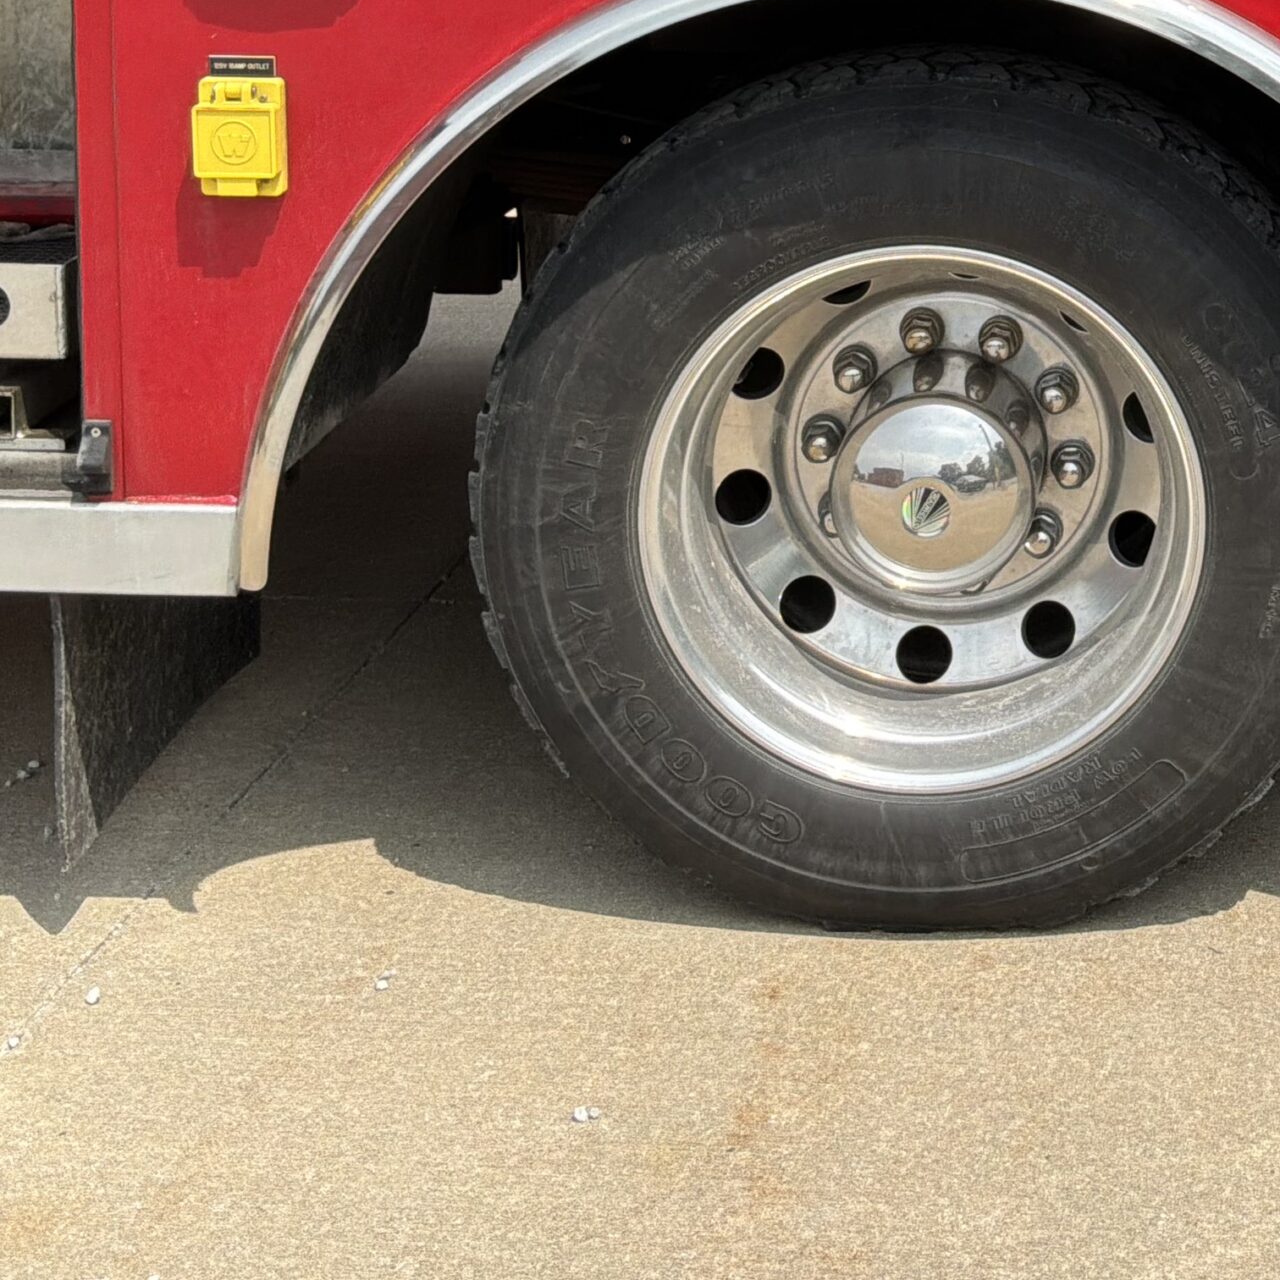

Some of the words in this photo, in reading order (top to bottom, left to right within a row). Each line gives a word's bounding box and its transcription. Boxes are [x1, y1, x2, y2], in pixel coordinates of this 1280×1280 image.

[247, 62, 270, 71] OUTLET
[560, 418, 802, 845] GOODYEAR
[1009, 754, 1104, 809] RADIAL
[1092, 747, 1143, 791] LOW
